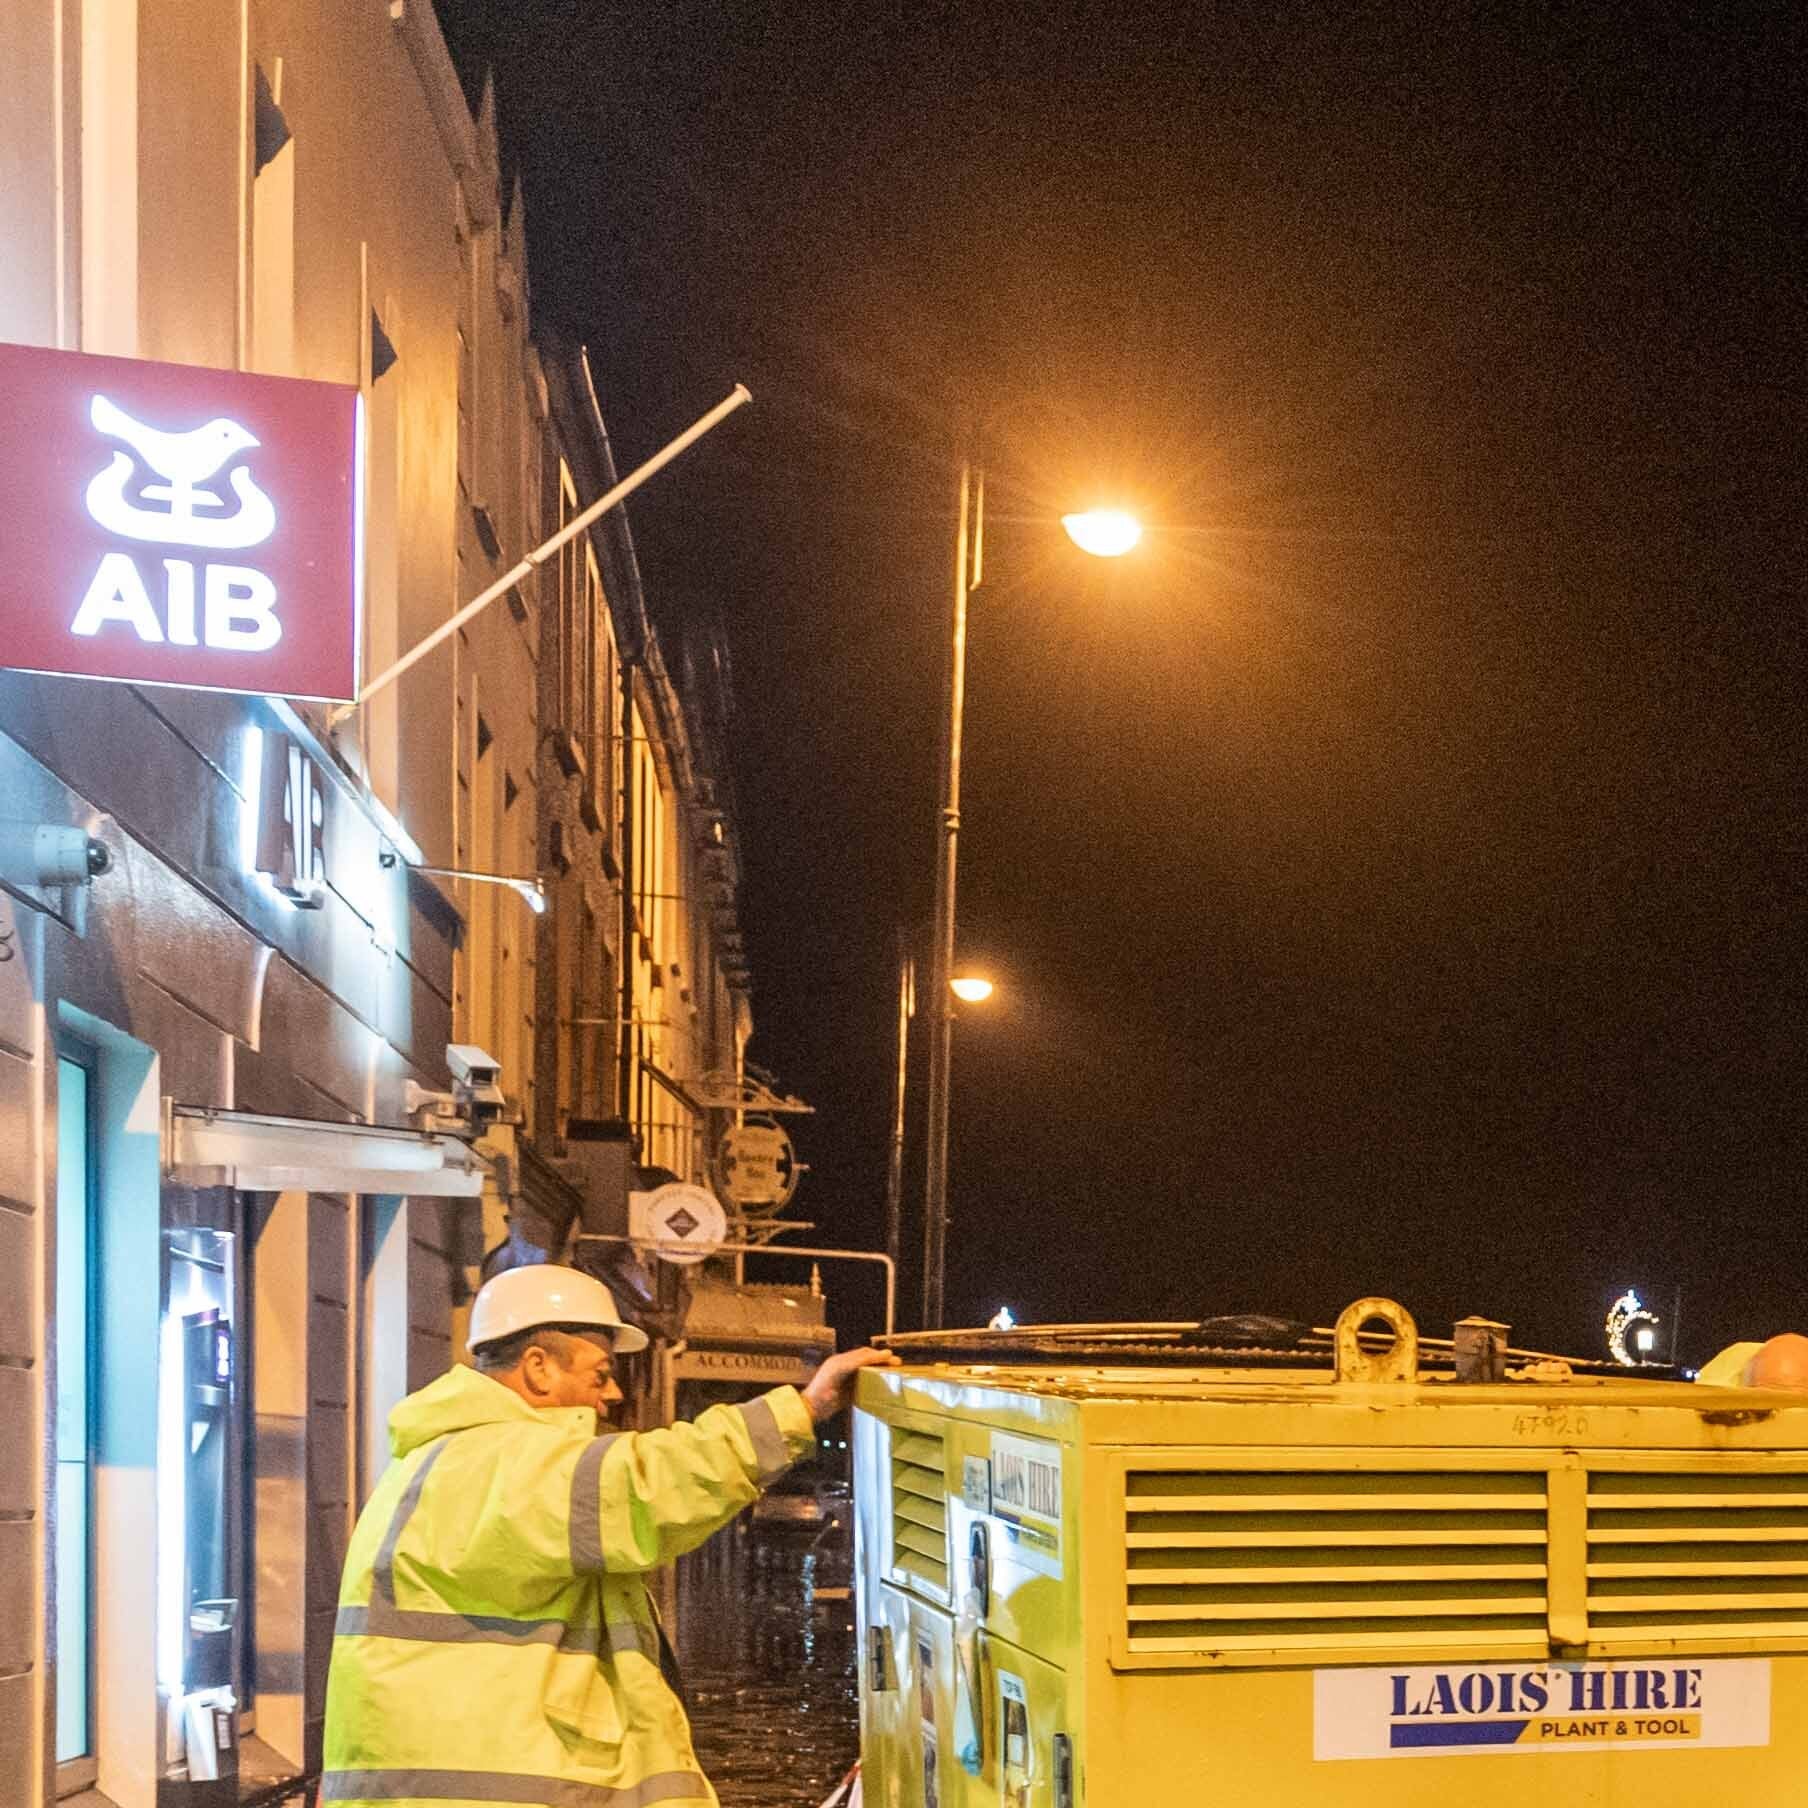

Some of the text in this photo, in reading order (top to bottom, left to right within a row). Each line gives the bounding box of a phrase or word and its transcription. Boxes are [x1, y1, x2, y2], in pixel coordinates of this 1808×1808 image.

[70, 553, 283, 652] AIB
[1028, 1460, 1060, 1519] HIRE
[1389, 1669, 1703, 1716] LAOIS HIRE
[1540, 1718, 1690, 1738] PLANT & TOOL
